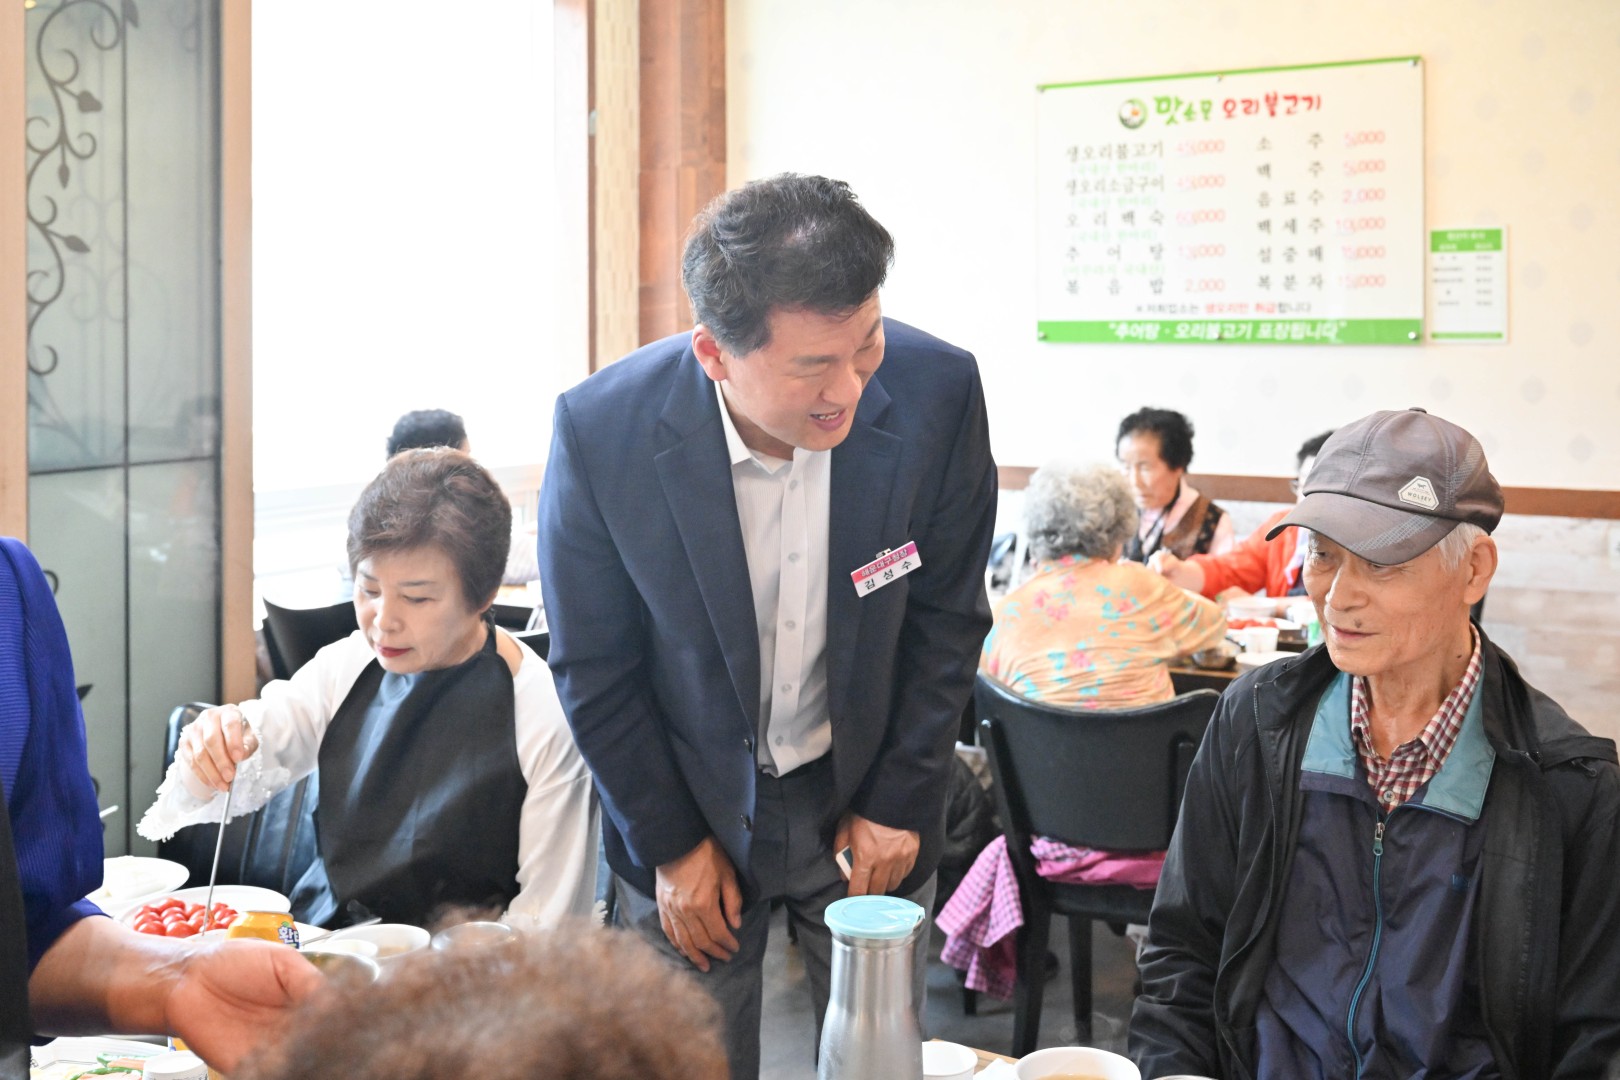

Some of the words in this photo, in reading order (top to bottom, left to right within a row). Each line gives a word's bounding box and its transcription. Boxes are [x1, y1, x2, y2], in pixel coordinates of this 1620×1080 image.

[1222, 91, 1322, 120] 오리불고기
[1066, 140, 1164, 163] 생오리불고기
[1066, 175, 1164, 196] 생오리소금구이
[1174, 321, 1253, 340] 오리불고기
[1407, 491, 1431, 502] WOLSEY
[864, 560, 912, 590] 김성수
